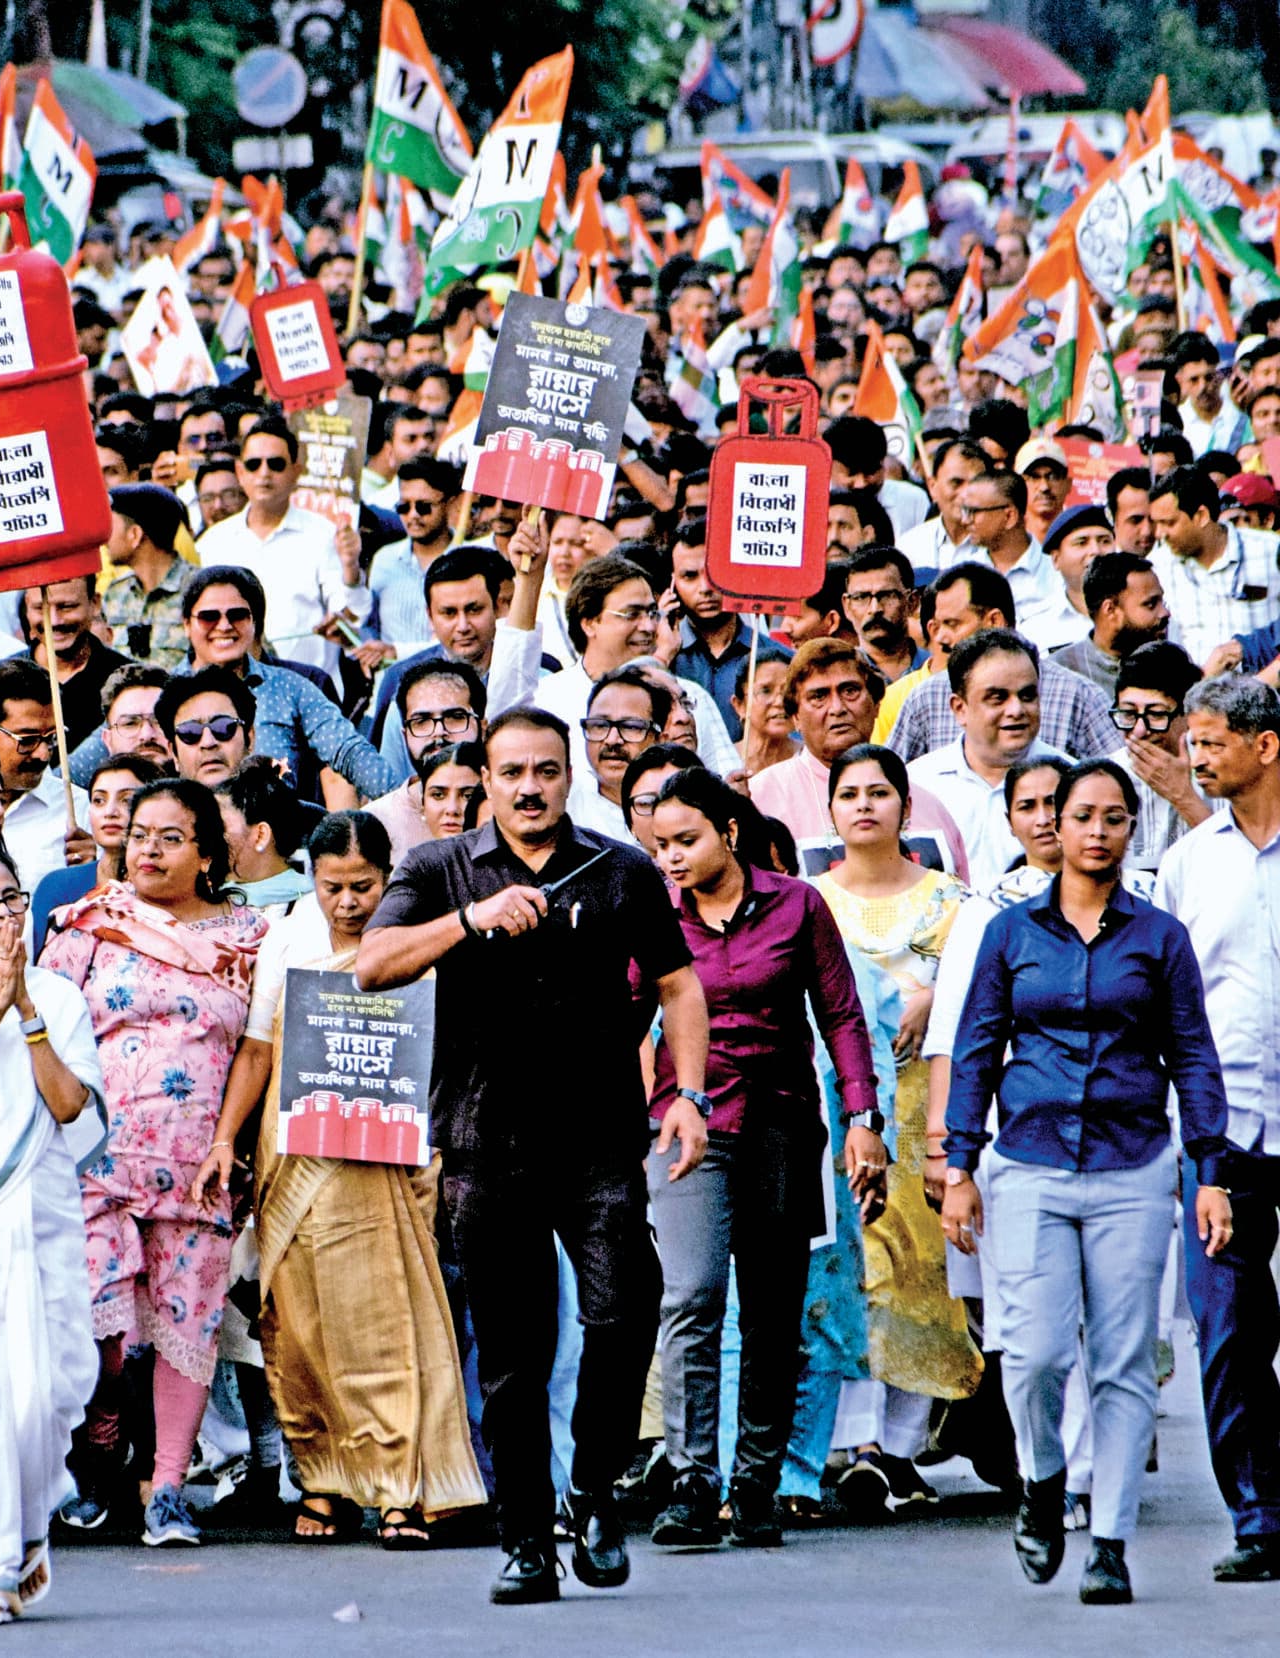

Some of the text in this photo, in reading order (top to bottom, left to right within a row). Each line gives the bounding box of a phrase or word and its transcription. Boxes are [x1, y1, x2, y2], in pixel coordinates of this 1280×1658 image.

[554, 351, 570, 366] না
[529, 364, 599, 398] রান্নার
[526, 387, 591, 418] গ্যাসে
[554, 416, 580, 433] দাম
[748, 473, 789, 487] বাংলা
[736, 515, 796, 534] বিজেপি
[348, 1018, 365, 1031] না
[324, 1031, 397, 1057] রান্নার
[325, 1052, 393, 1075] গ্যাসে
[360, 1076, 386, 1090] দাম
